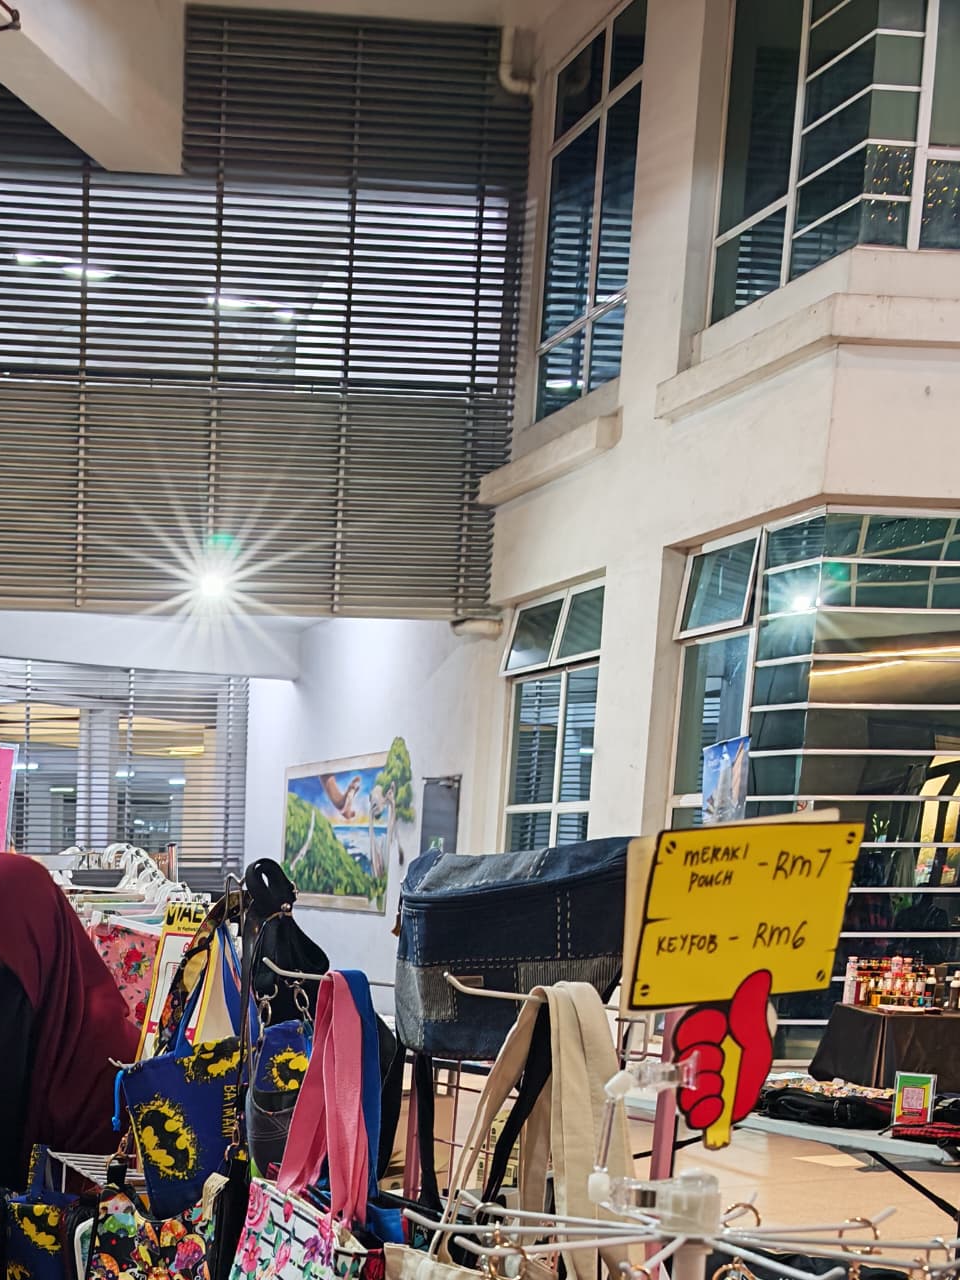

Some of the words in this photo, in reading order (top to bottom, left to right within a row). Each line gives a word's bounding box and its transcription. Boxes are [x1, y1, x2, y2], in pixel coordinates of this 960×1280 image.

[683, 843, 749, 867] MERAKI
[688, 870, 734, 893] POUCH
[656, 934, 718, 956] KEYFOB
